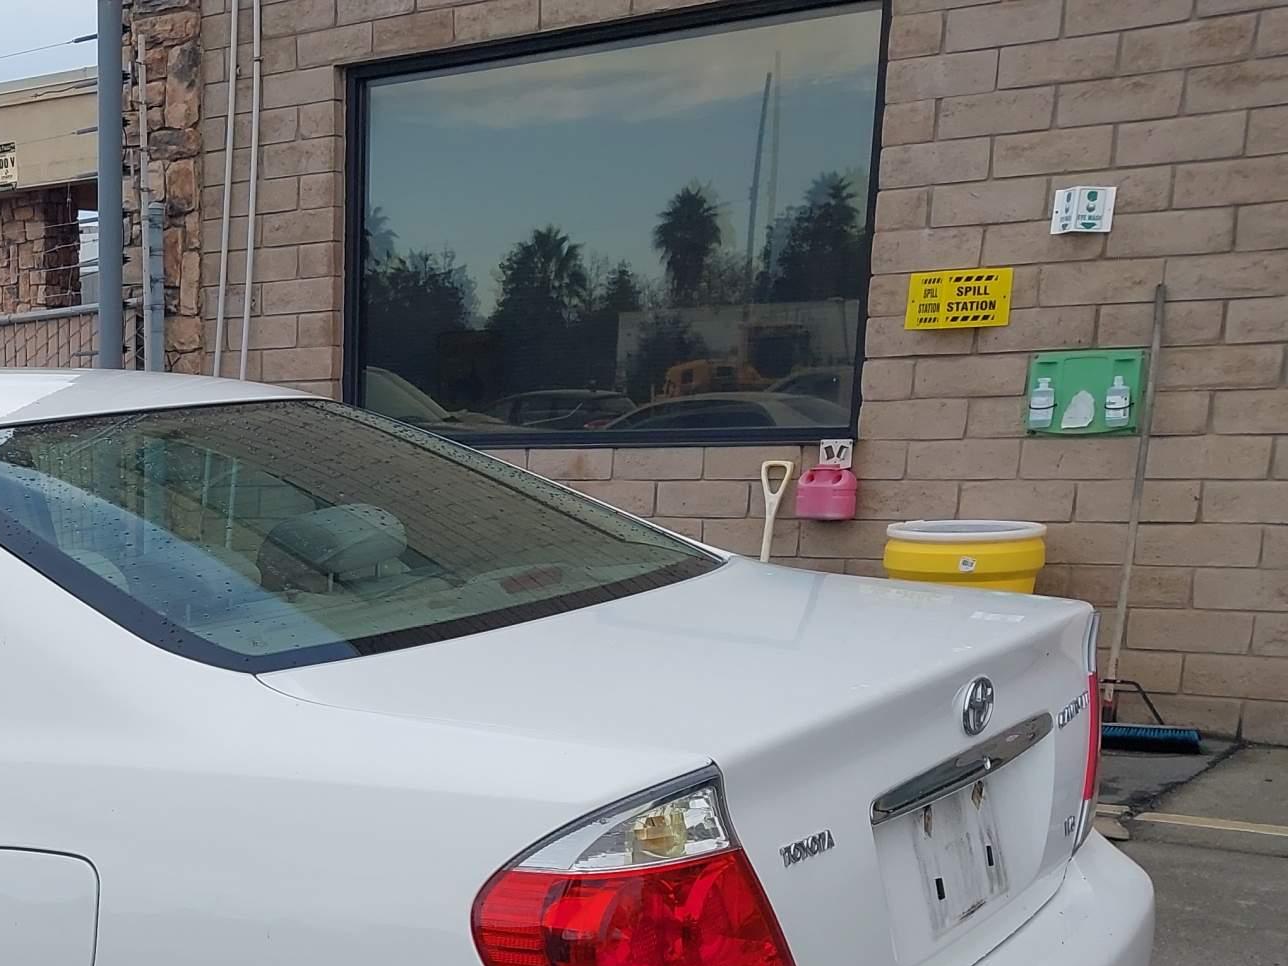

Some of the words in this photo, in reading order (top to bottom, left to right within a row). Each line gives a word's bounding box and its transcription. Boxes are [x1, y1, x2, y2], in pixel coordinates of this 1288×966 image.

[10, 156, 14, 167] V
[923, 288, 939, 300] SPILL
[956, 286, 990, 297] SPILL
[918, 303, 940, 315] STATION
[946, 300, 997, 313] STATION
[779, 829, 835, 868] TOYOTA
